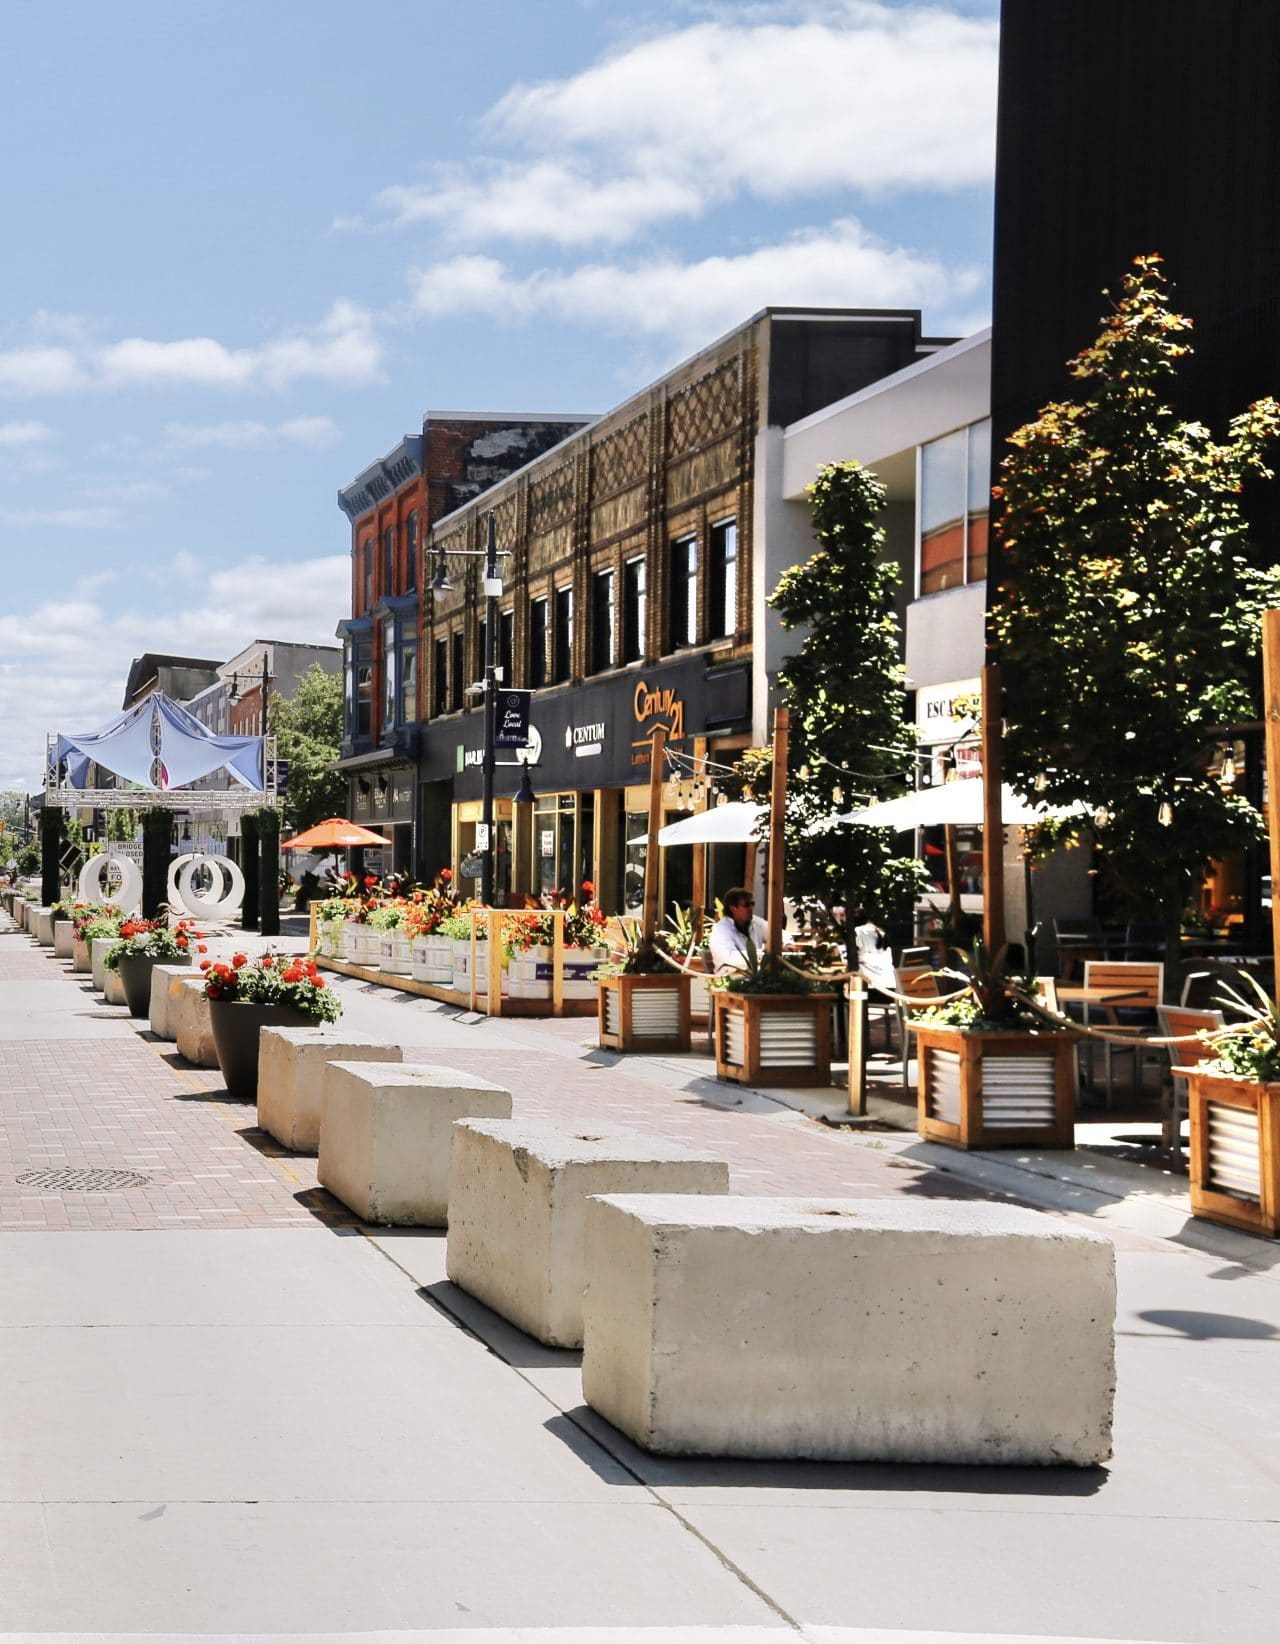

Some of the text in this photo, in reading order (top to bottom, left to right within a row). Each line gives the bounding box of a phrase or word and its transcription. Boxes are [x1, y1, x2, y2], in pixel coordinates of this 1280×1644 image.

[634, 680, 674, 722] Century
[503, 720, 522, 728] Local
[504, 711, 521, 719] Love
[669, 700, 683, 741] 21
[573, 722, 605, 744] CENTUM
